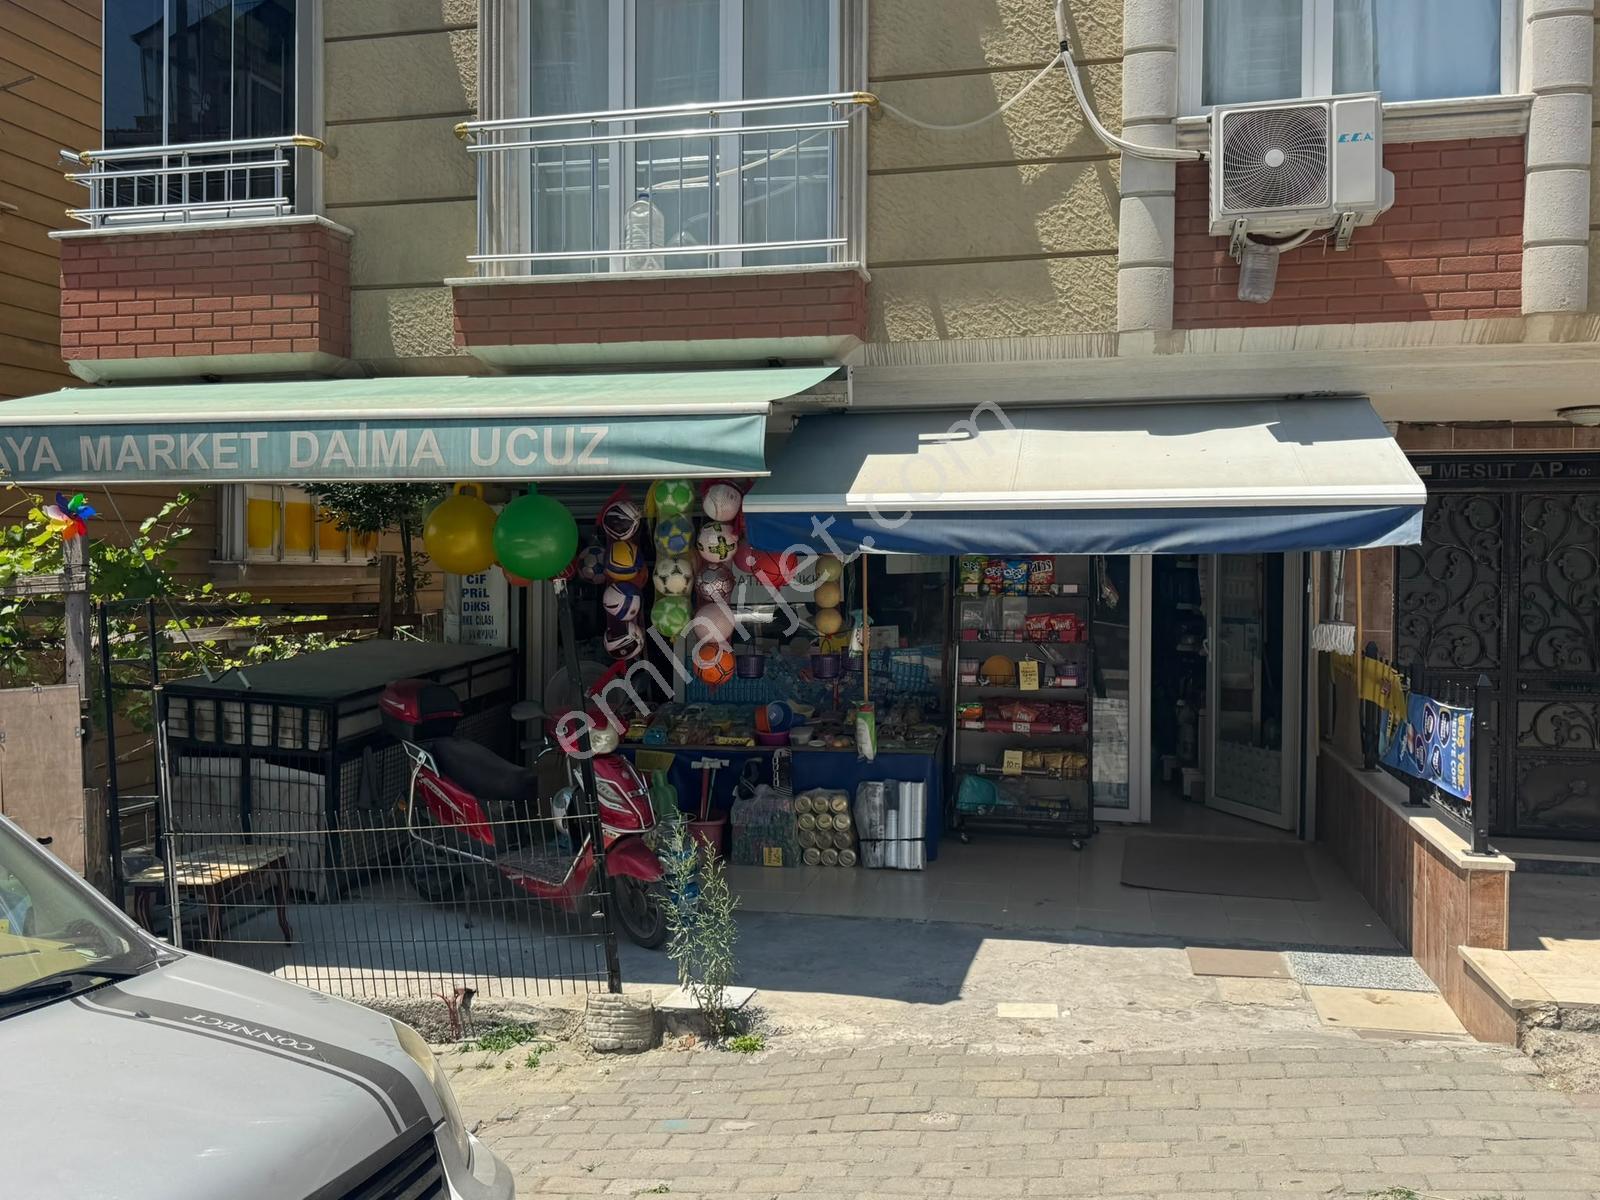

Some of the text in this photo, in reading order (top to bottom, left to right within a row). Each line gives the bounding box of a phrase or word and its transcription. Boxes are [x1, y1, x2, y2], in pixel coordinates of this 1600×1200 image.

[79, 432, 268, 471] MARKET
[288, 422, 447, 470] DAİMA
[469, 424, 609, 468] UCUZ
[1439, 462, 1517, 479] MESUT
[183, 1014, 317, 1051] CONNECT
